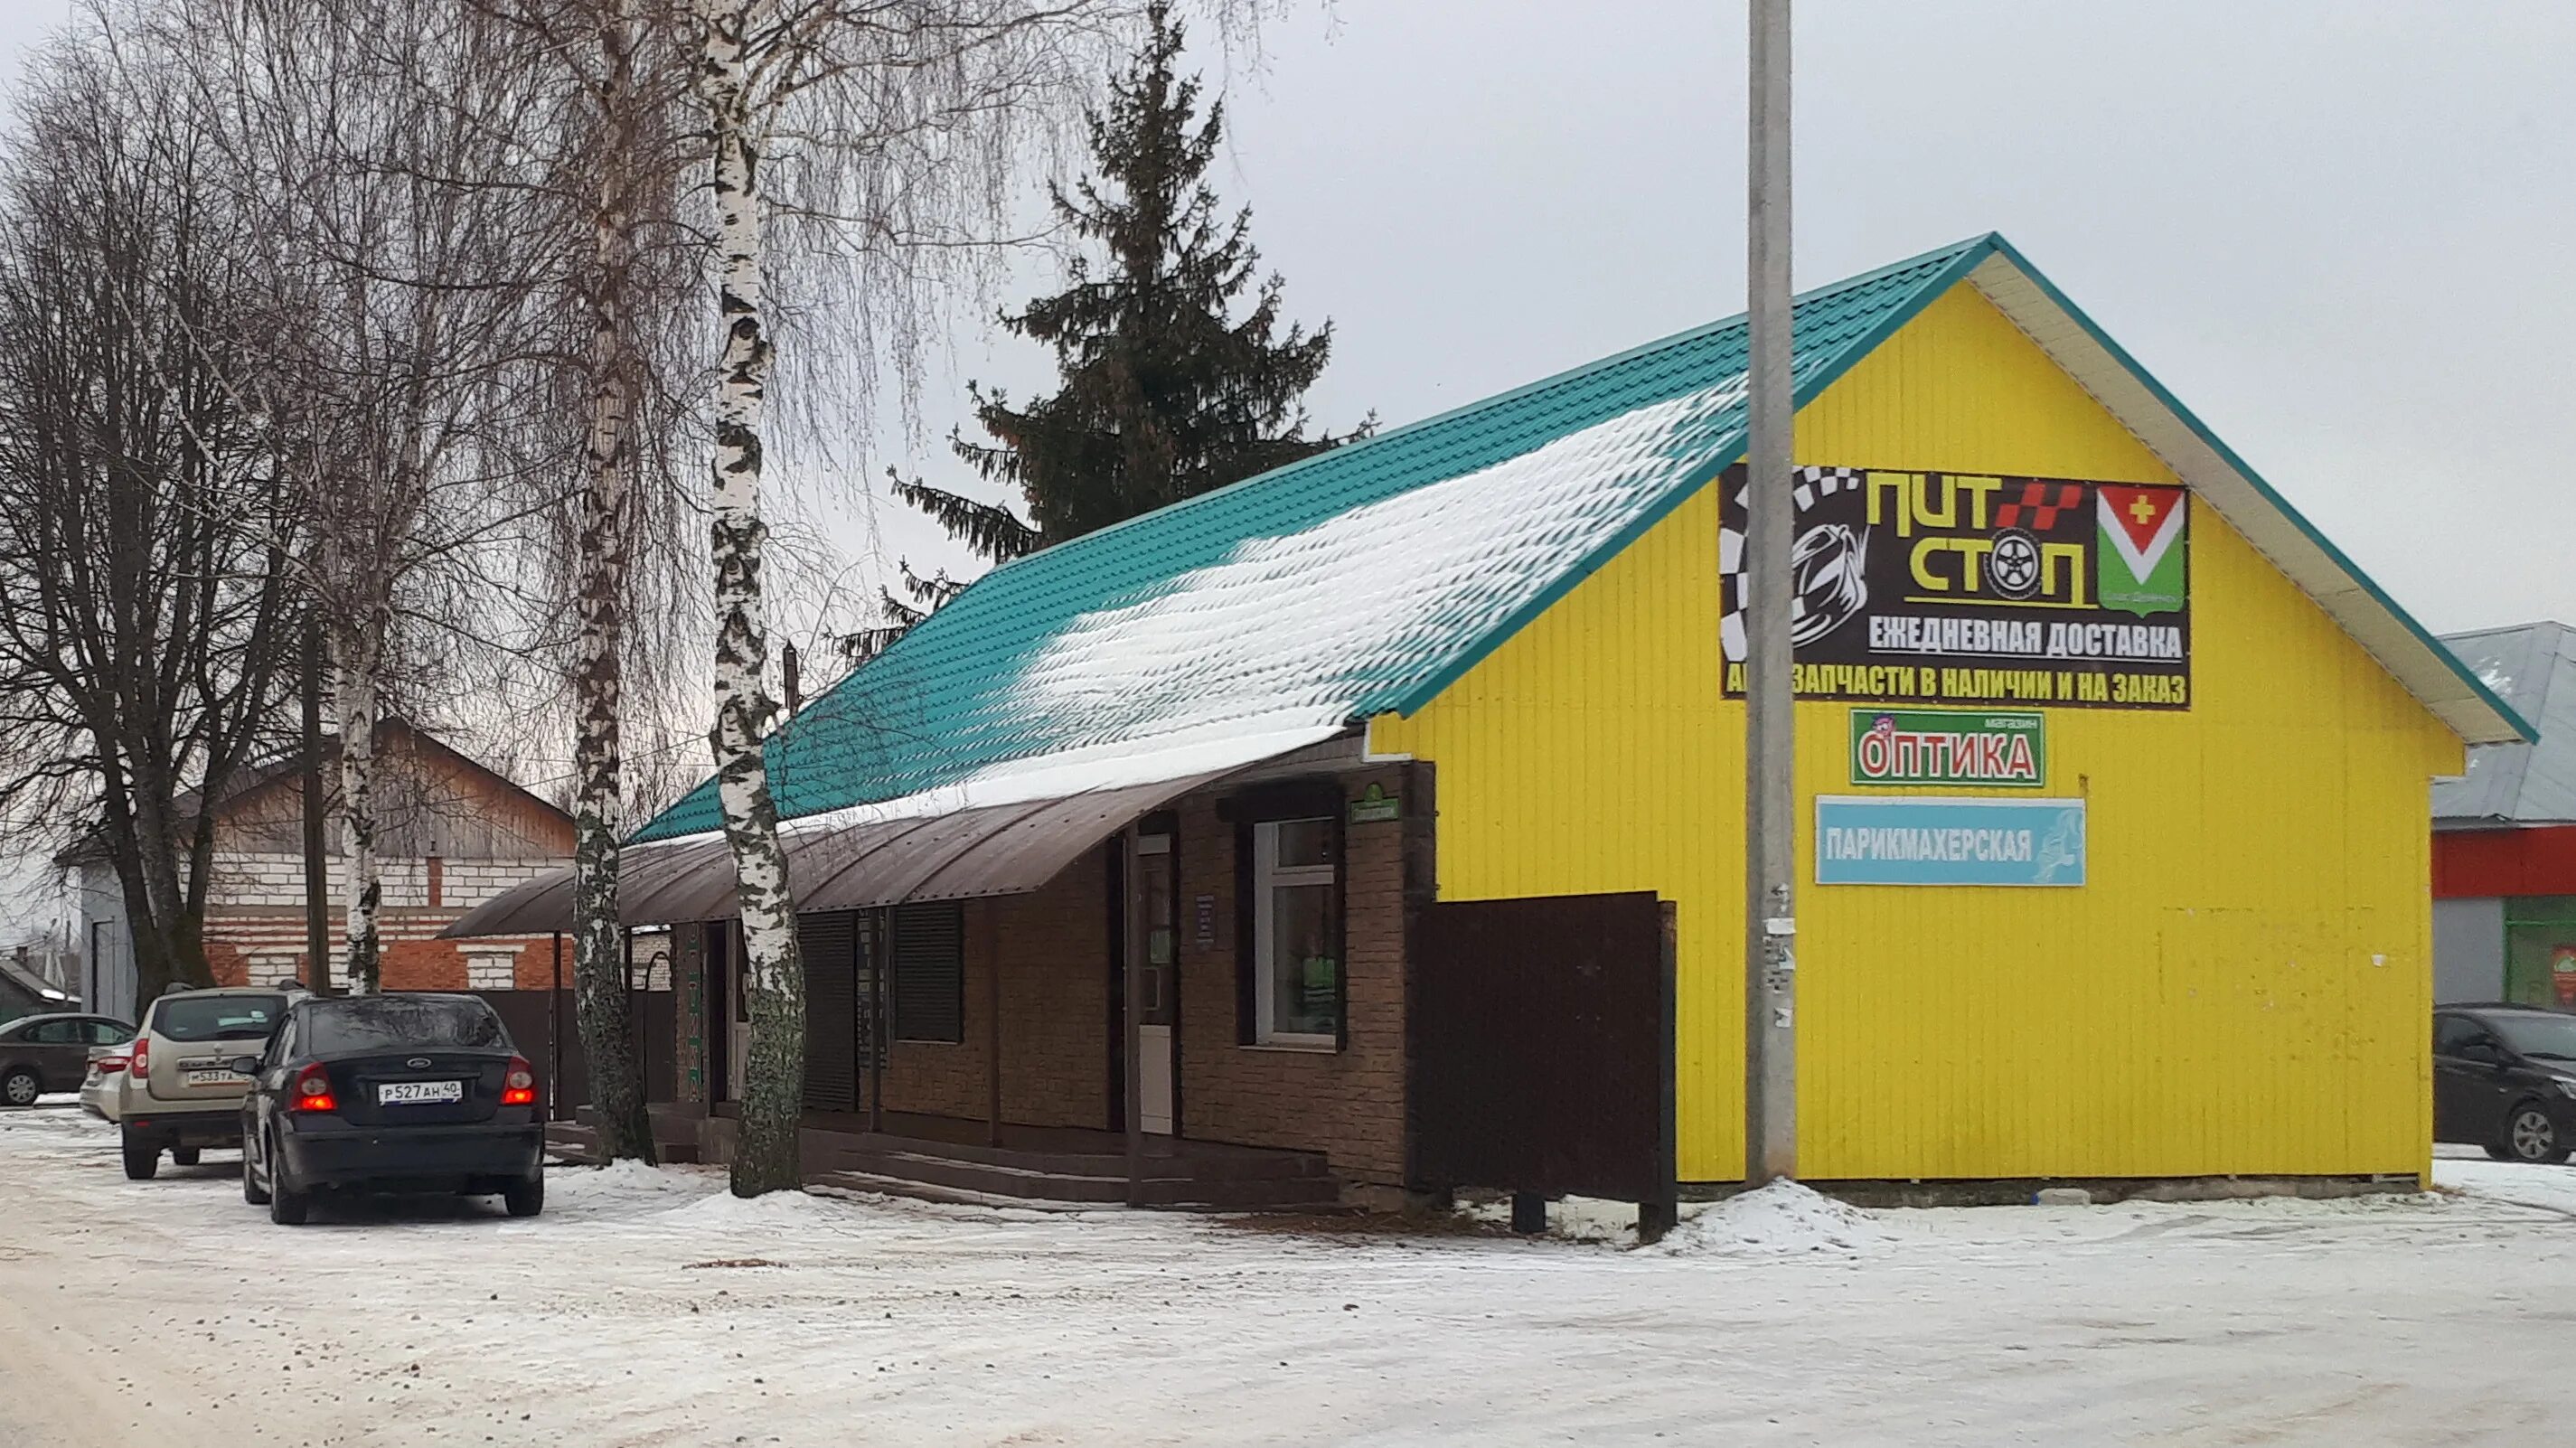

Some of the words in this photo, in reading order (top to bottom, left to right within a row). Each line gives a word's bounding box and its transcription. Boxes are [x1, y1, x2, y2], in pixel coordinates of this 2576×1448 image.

[1866, 472, 2003, 538] ПИТ
[1868, 616, 2041, 654] ЕЖЕДНЕВНАЯ
[2046, 622, 2183, 659] ДОСТАВКА
[1726, 663, 1915, 695] АЗАПЧАСТИ
[1920, 667, 1937, 697] В
[1941, 669, 2051, 699] НАЛИЧИИ
[2057, 672, 2073, 700] И
[2078, 673, 2107, 701] НА
[2111, 674, 2186, 704] ЗАКАЗ
[1858, 731, 2037, 779] ОПТИКА
[1825, 827, 2032, 861] ПАРИКМАХЕРСКАЯ
